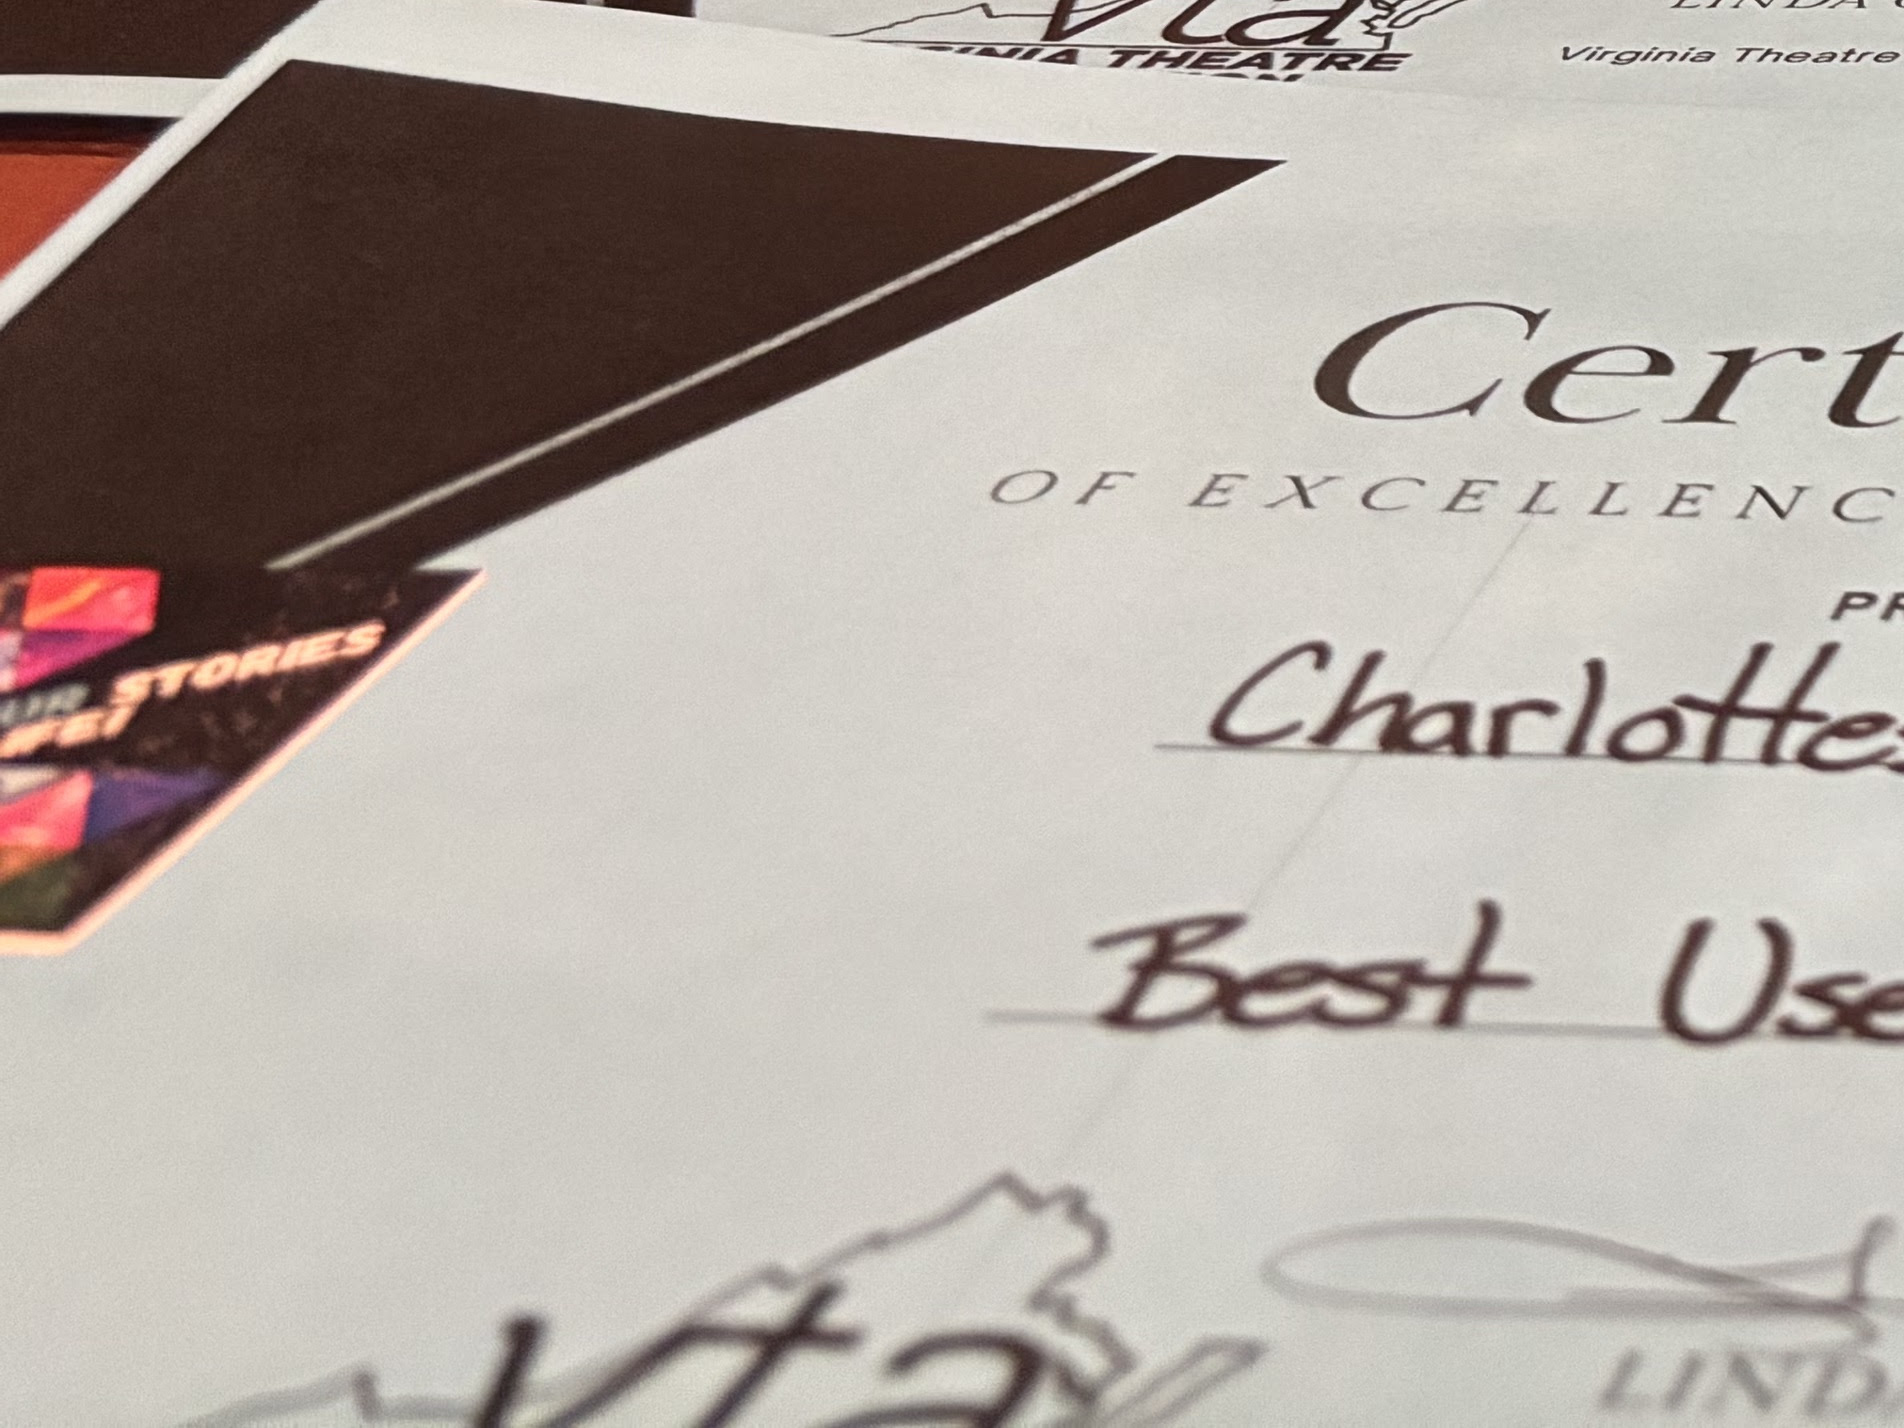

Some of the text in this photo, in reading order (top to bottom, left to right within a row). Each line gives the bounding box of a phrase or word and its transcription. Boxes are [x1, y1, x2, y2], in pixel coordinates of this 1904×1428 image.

[1105, 48, 1415, 73] THEATRE
[1558, 43, 1718, 68] Virginia
[986, 469, 1138, 510] OF
[110, 619, 387, 705] STORIES
[1085, 894, 1536, 1036] Best
